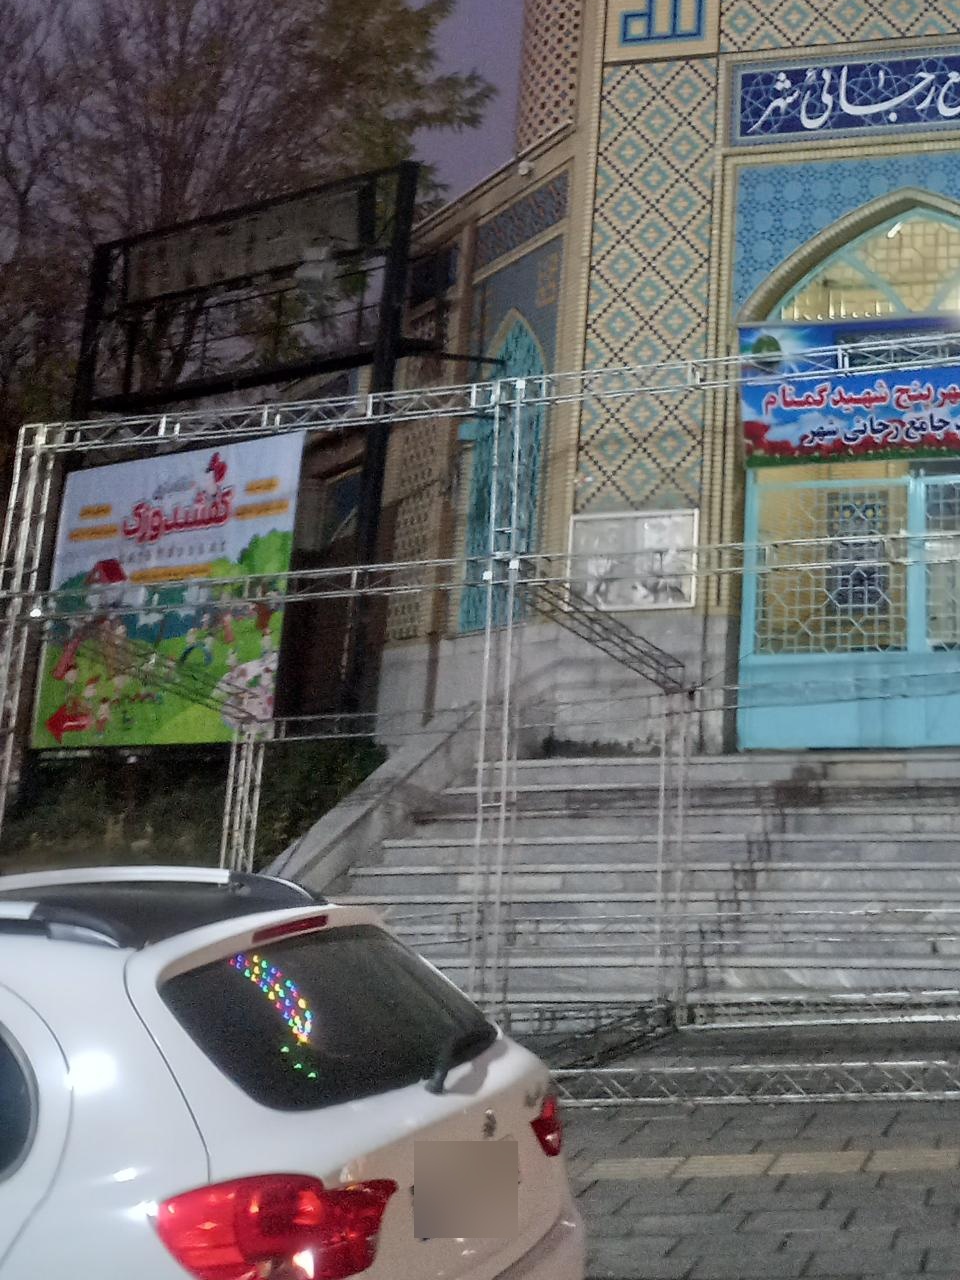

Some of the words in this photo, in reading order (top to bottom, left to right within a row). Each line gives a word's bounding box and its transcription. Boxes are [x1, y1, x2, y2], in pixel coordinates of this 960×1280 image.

[746, 71, 800, 133] شهر
[763, 382, 831, 415] گمنام
[830, 379, 890, 413] شهید
[894, 380, 935, 410] پنج
[802, 420, 839, 447] شهر
[904, 412, 951, 440] جامع
